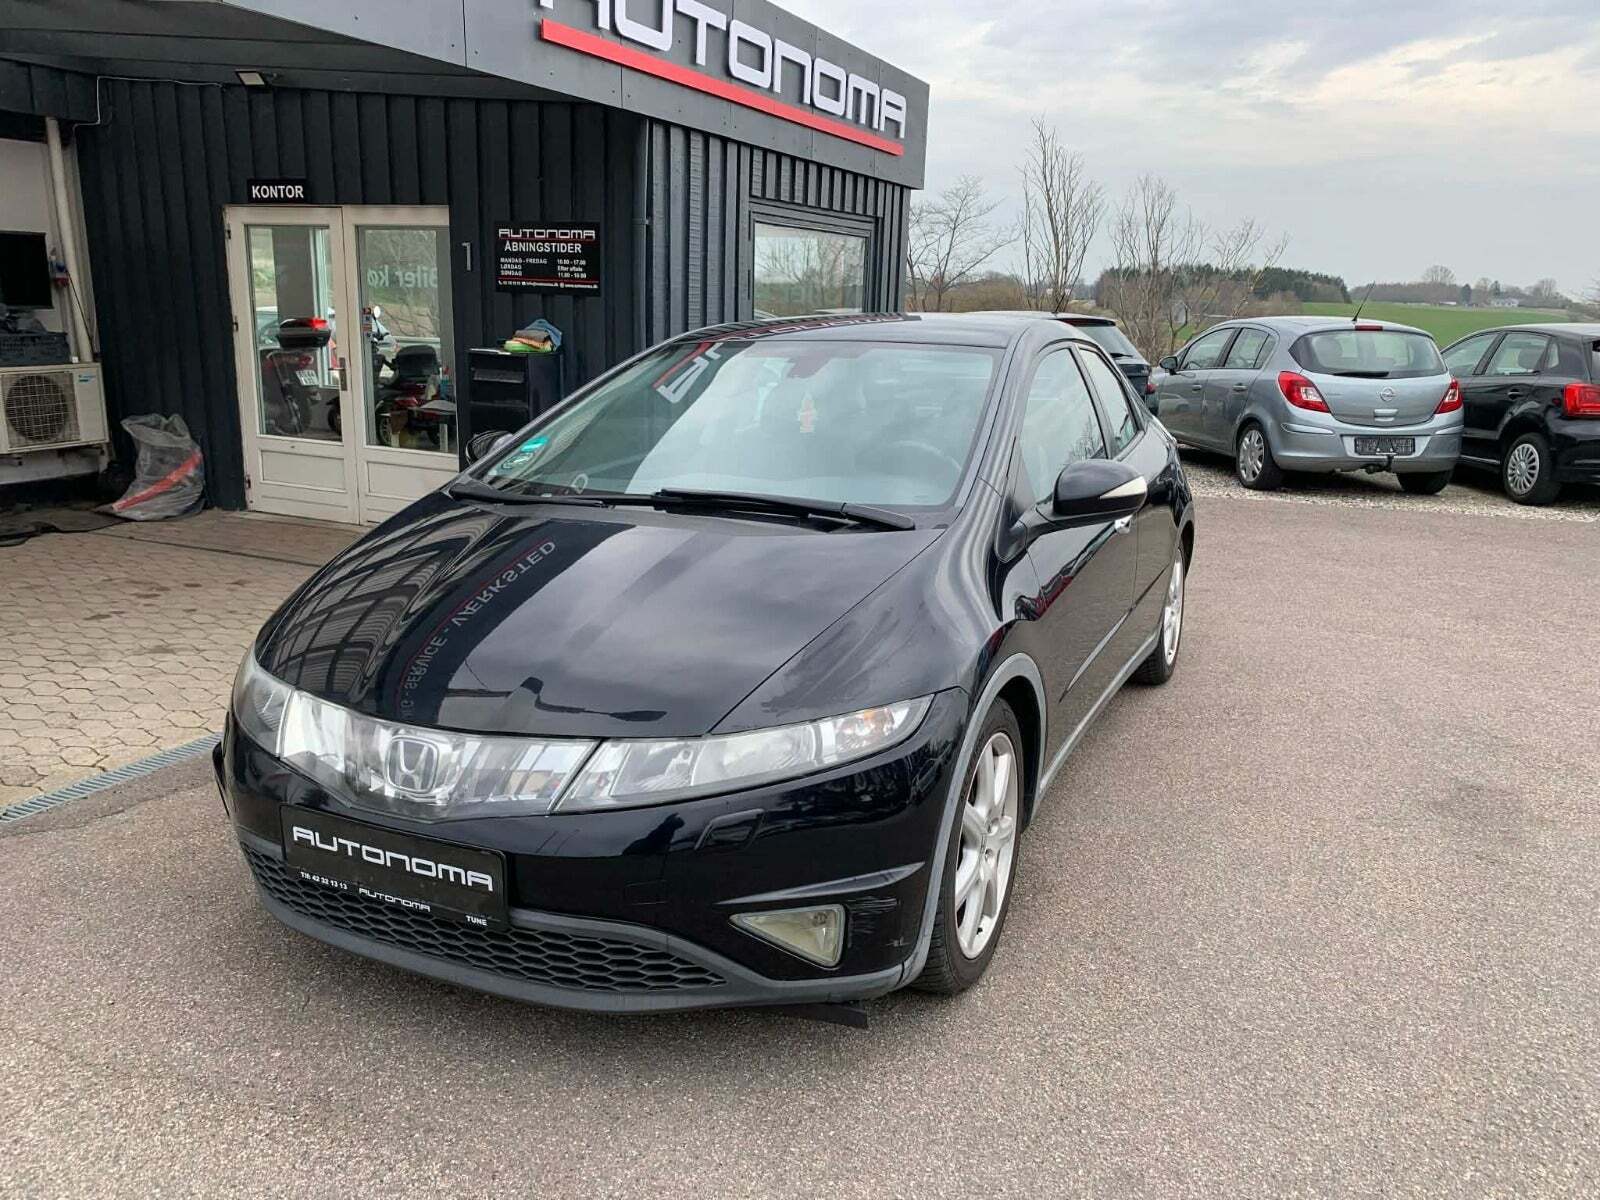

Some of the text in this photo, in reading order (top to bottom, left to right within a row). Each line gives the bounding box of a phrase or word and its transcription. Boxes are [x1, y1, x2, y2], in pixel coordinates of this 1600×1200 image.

[251, 185, 304, 199] KONTOR
[498, 228, 596, 240] AUTONOMA
[504, 240, 582, 253] ÅBNINGSTIDER
[292, 825, 493, 892] AUTONOMA
[358, 887, 431, 913] AUTONOMA
[465, 914, 488, 927] TUNE
